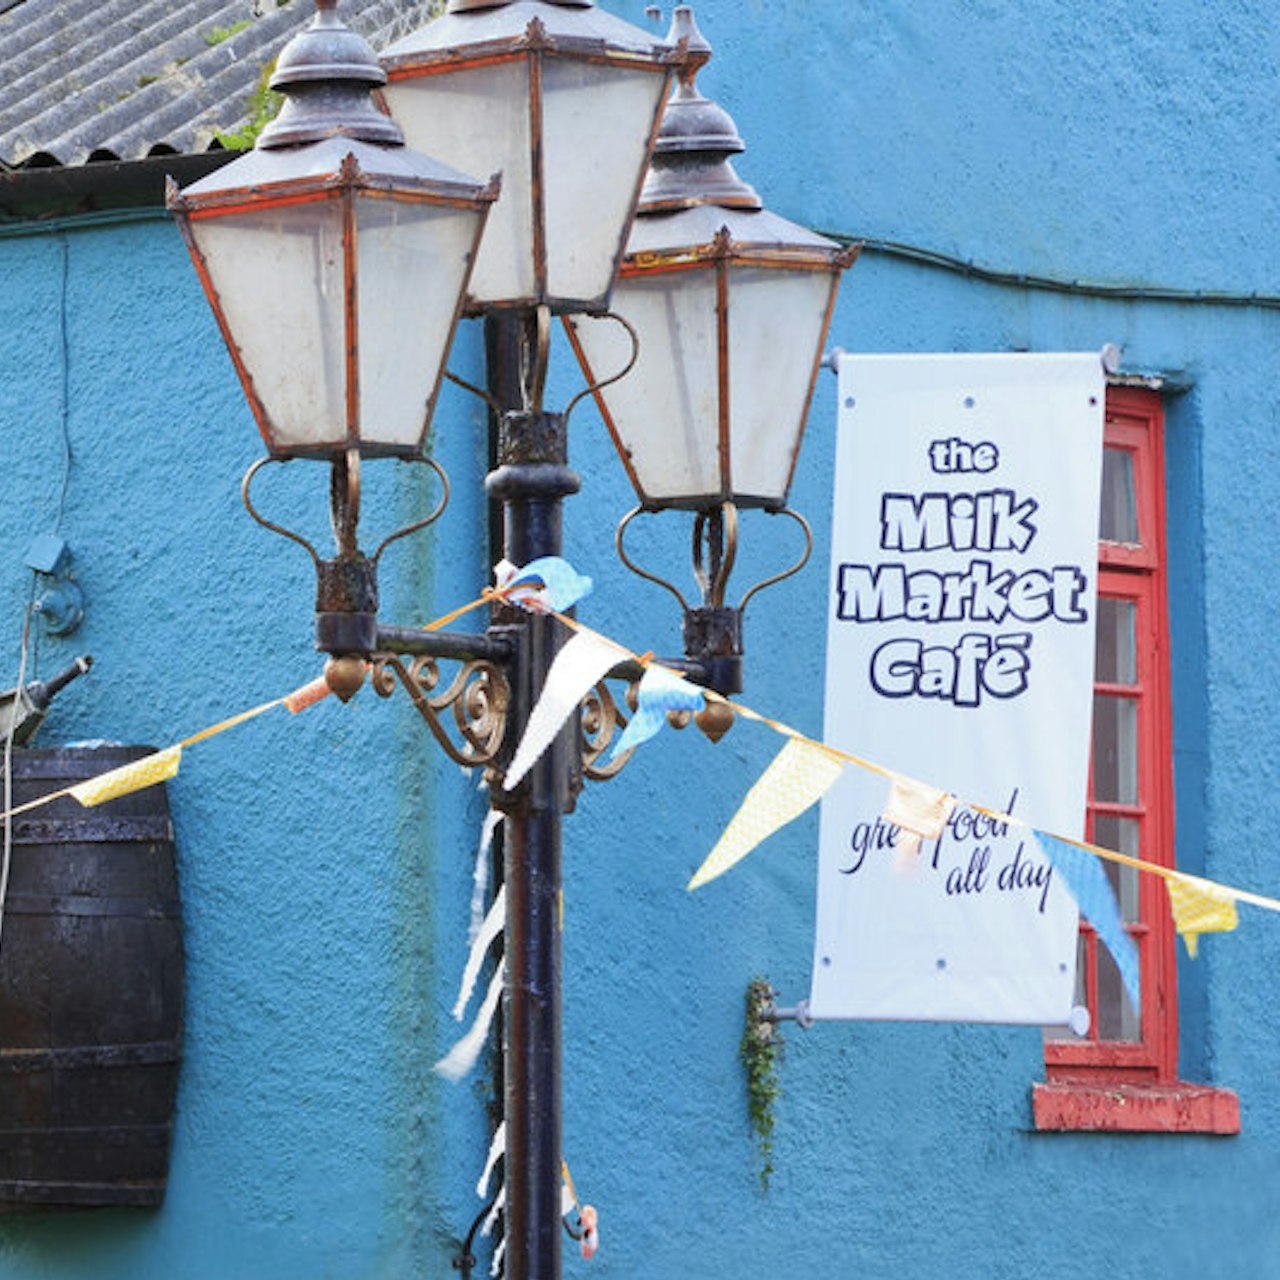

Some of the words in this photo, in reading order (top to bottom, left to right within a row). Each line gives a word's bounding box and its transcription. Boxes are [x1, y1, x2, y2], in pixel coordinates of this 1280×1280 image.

[929, 438, 999, 474] the
[881, 488, 1039, 553] Milk
[837, 560, 1088, 624] Market
[870, 633, 1032, 708] Café
[839, 812, 923, 875] gre
[946, 845, 993, 896] all
[998, 842, 1053, 914] day
